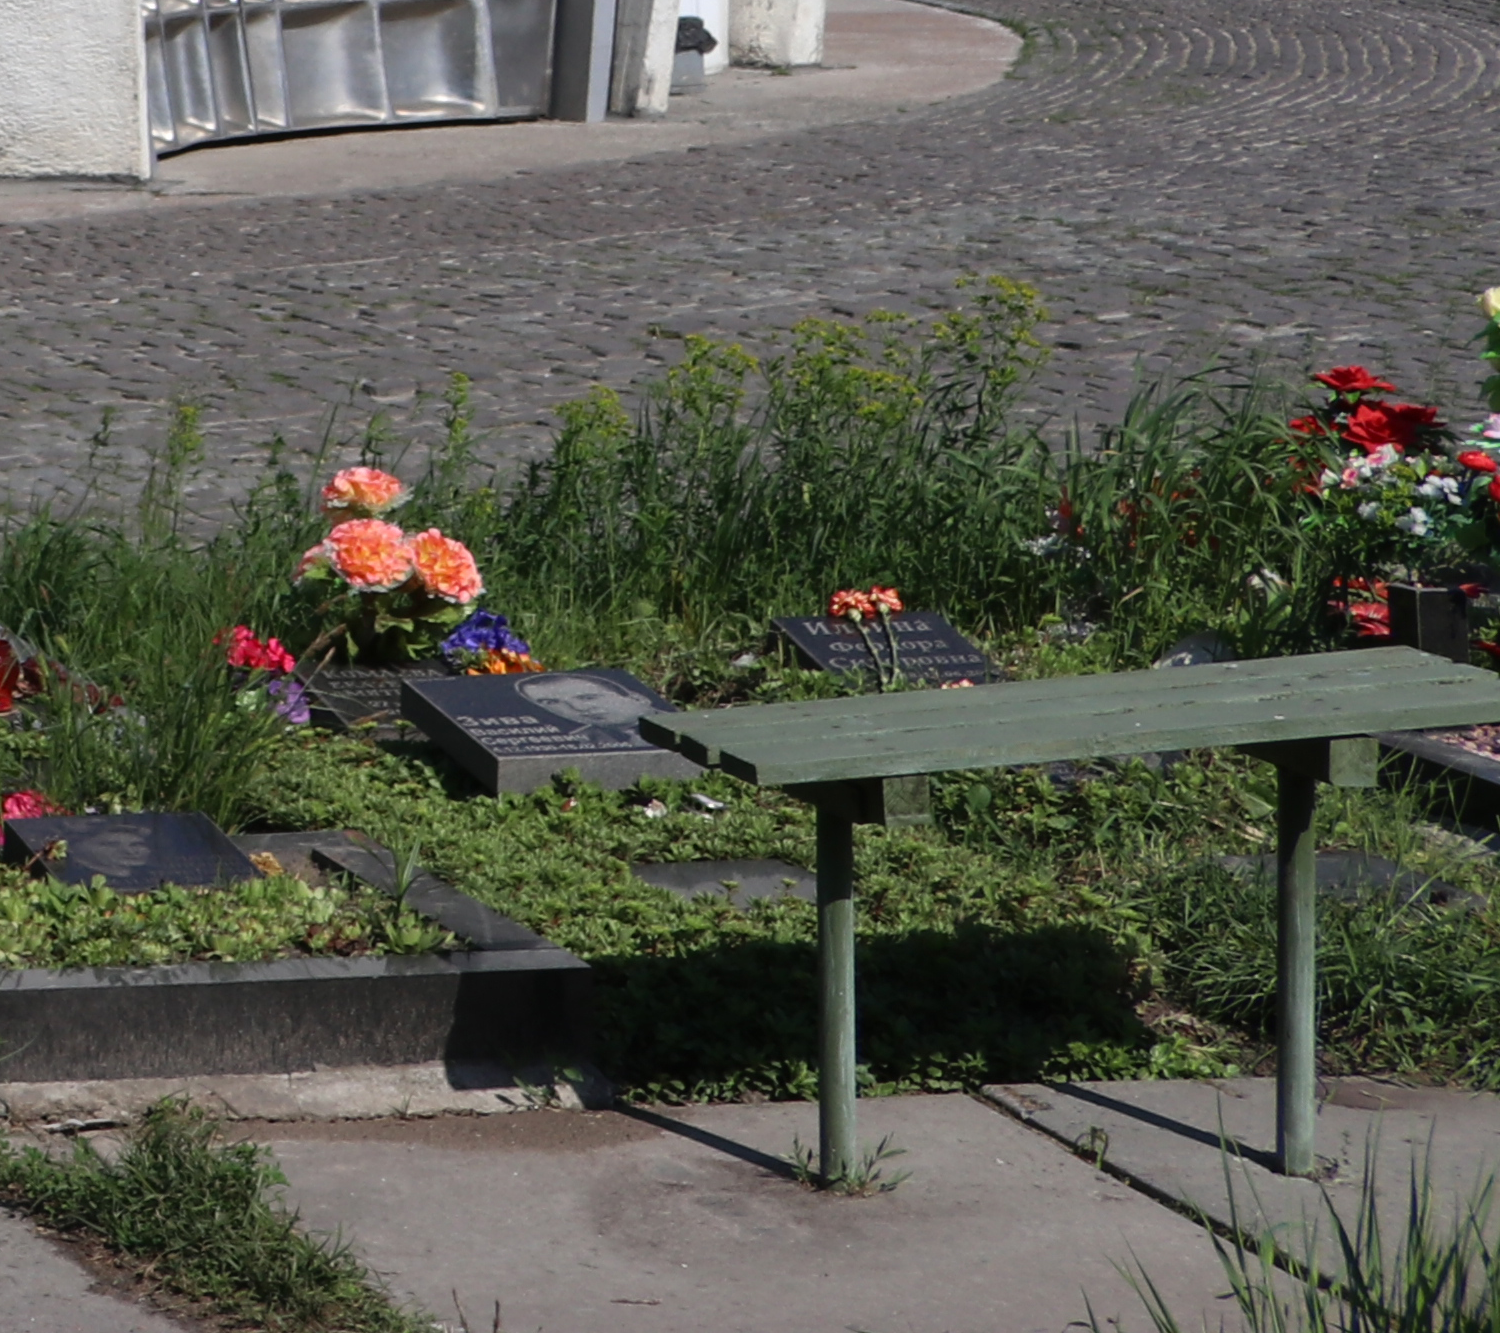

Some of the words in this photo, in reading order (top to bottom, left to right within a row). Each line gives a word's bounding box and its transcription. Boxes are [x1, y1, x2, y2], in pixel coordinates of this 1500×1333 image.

[803, 619, 931, 636] Илина
[828, 638, 950, 654] Феоора
[456, 715, 540, 727] Зива
[469, 724, 561, 737] Василий
[481, 734, 590, 746] Сергеевич
